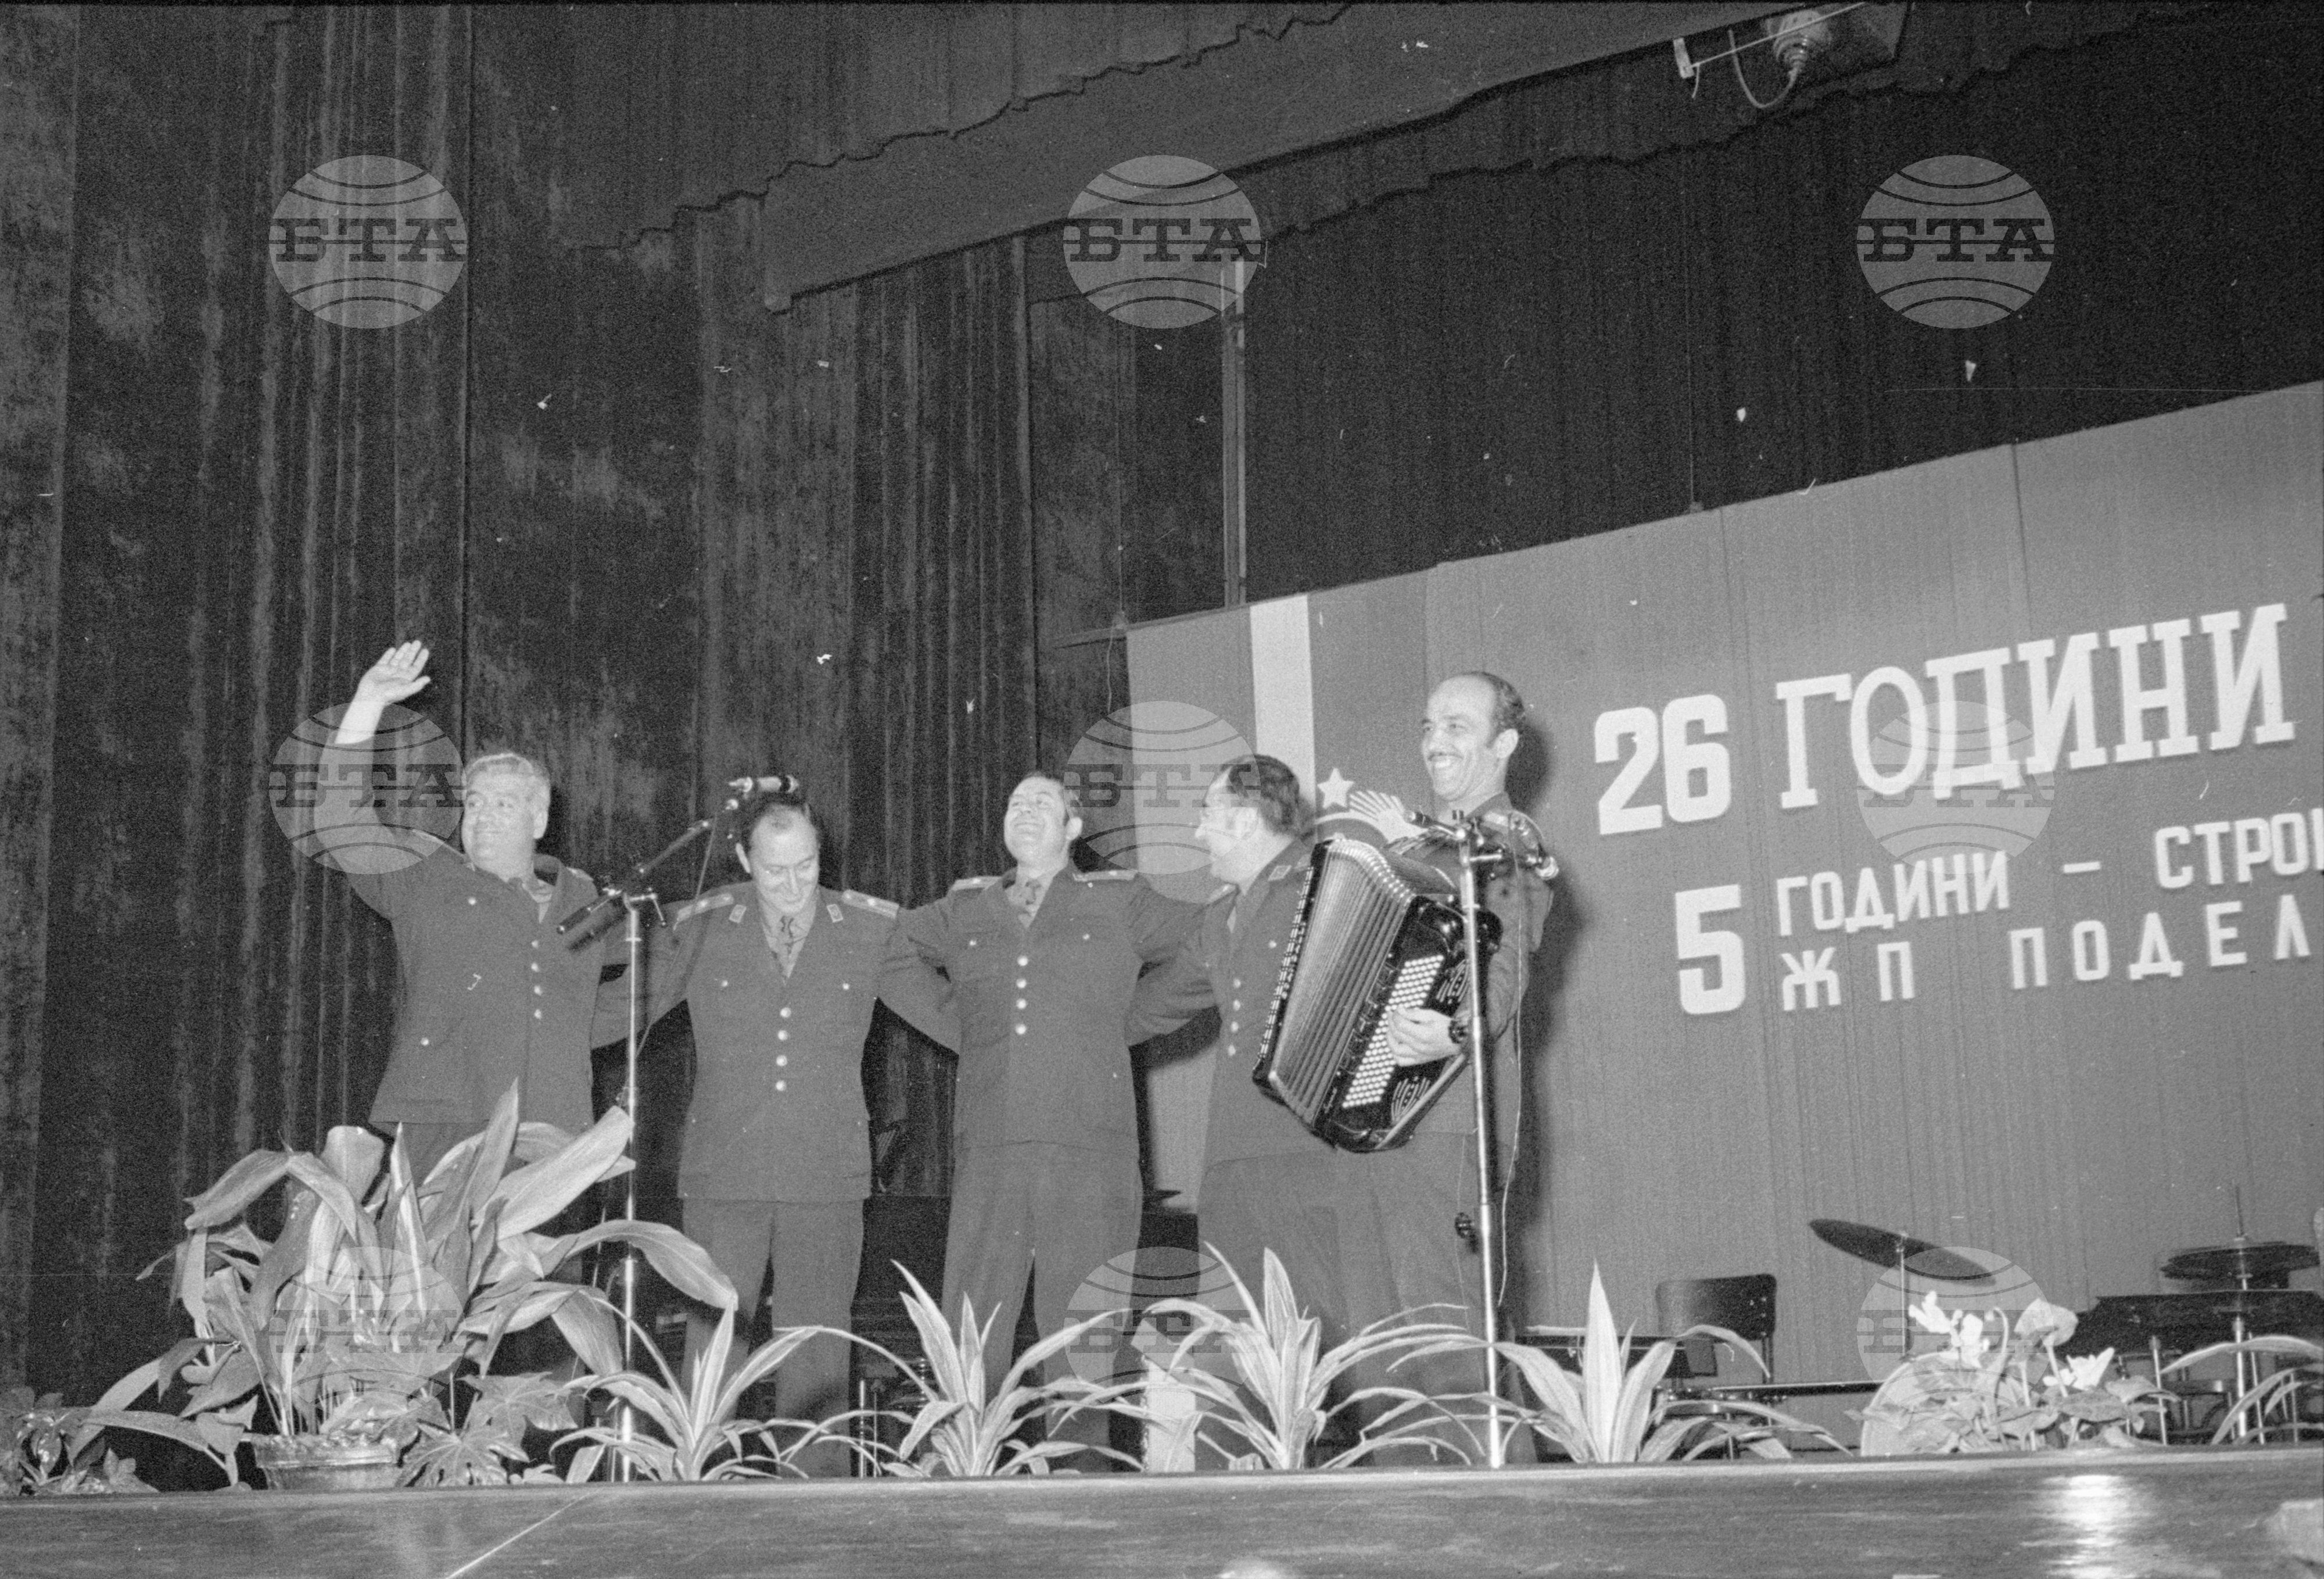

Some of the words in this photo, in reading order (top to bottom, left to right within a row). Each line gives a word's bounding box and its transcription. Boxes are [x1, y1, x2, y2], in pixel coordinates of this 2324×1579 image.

[1593, 693, 1733, 836] 26
[1776, 603, 2294, 810] ГОДИНИ
[1673, 883, 1746, 1015] 5
[1776, 848, 2010, 936] ГОДИНИ
